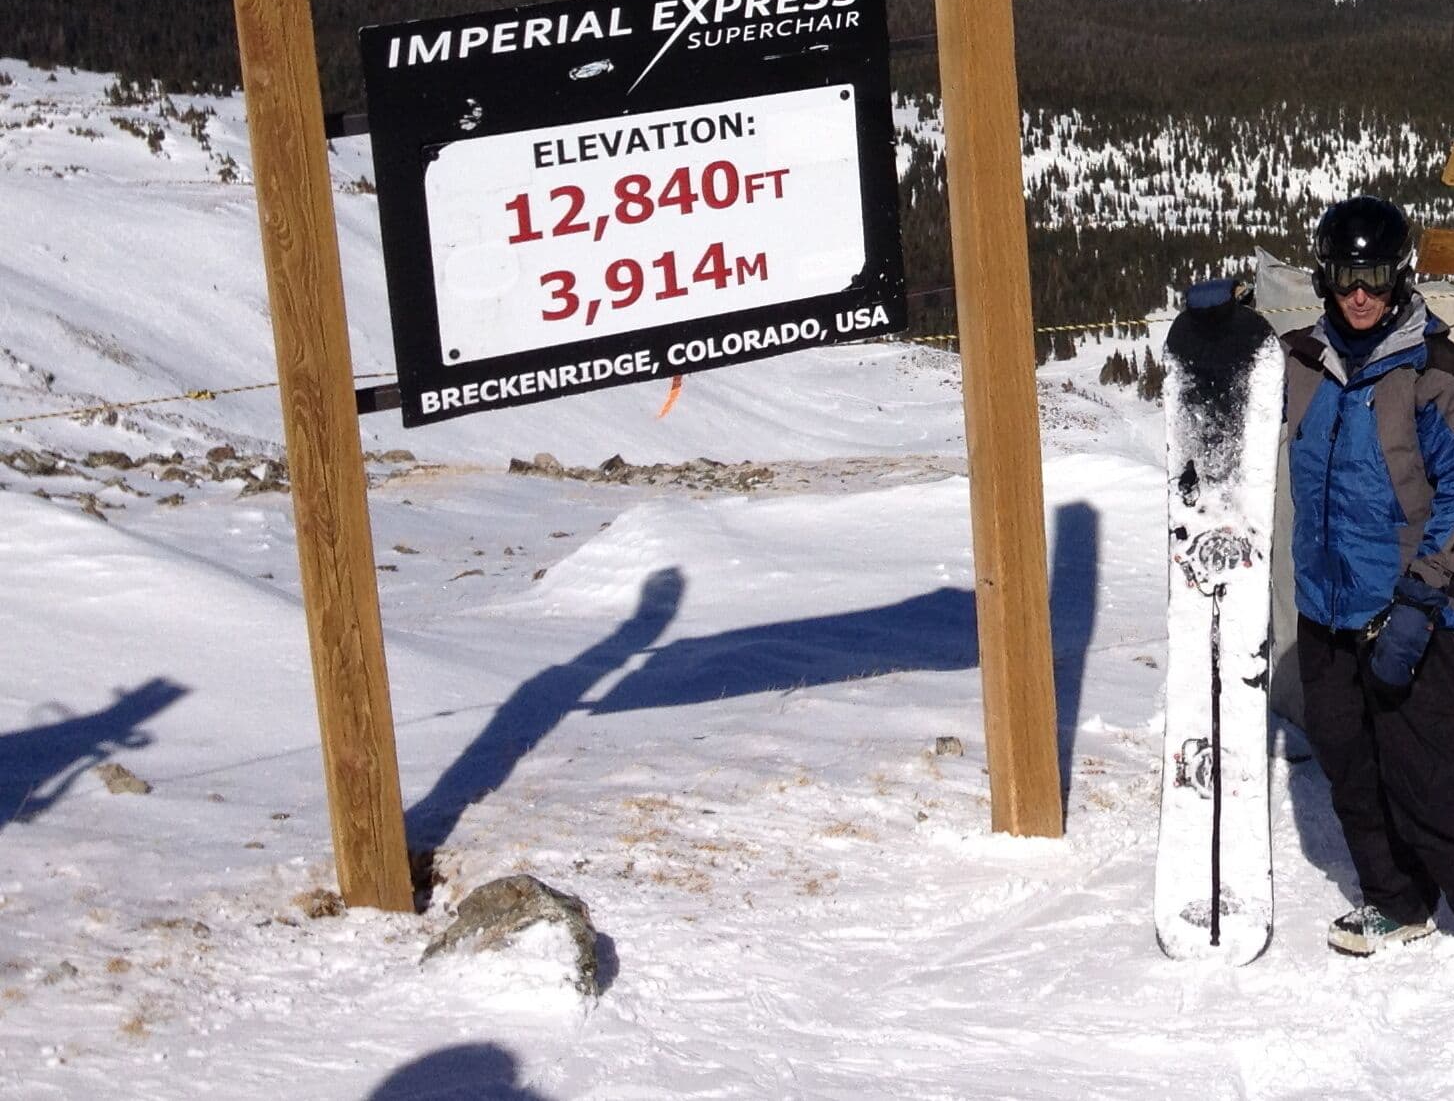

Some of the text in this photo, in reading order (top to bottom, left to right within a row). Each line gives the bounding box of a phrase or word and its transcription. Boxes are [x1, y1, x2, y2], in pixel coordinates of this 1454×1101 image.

[388, 6, 633, 69] IMPERIAL
[686, 10, 860, 50] SUPERCHAIR
[532, 112, 756, 168] ELEVATION:
[420, 304, 889, 415] BRECKENRIDGE, COLORADO, USA
